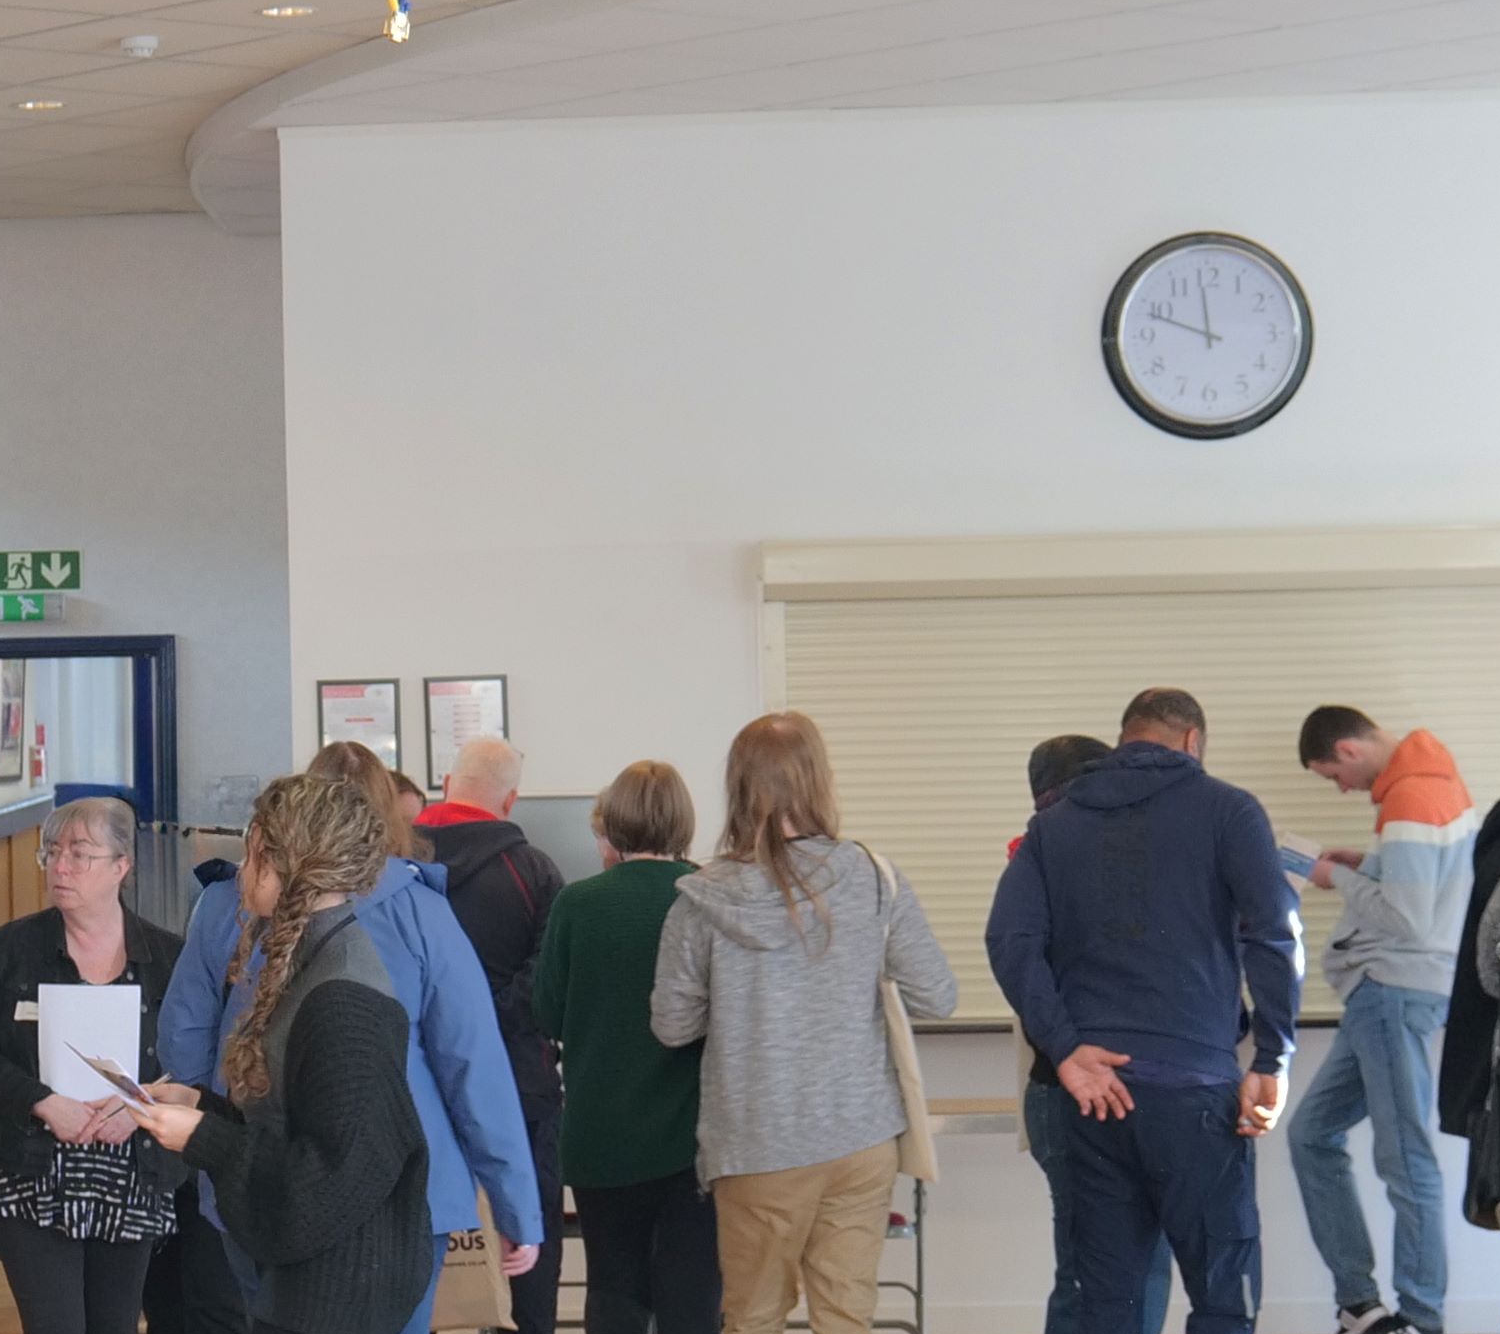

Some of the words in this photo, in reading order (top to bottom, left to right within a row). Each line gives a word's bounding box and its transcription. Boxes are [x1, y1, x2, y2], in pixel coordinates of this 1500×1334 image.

[1171, 277, 1188, 297] 11
[1196, 268, 1219, 288] 12
[1234, 275, 1241, 294] 1
[1150, 301, 1173, 320] 10
[1253, 293, 1265, 313] 2
[1140, 327, 1155, 344] 9
[1267, 323, 1278, 343] 3
[1150, 357, 1165, 375] 8
[1254, 355, 1267, 371] 4
[1176, 376, 1188, 396] 7
[1202, 383, 1217, 402] 6
[1235, 374, 1248, 393] 5
